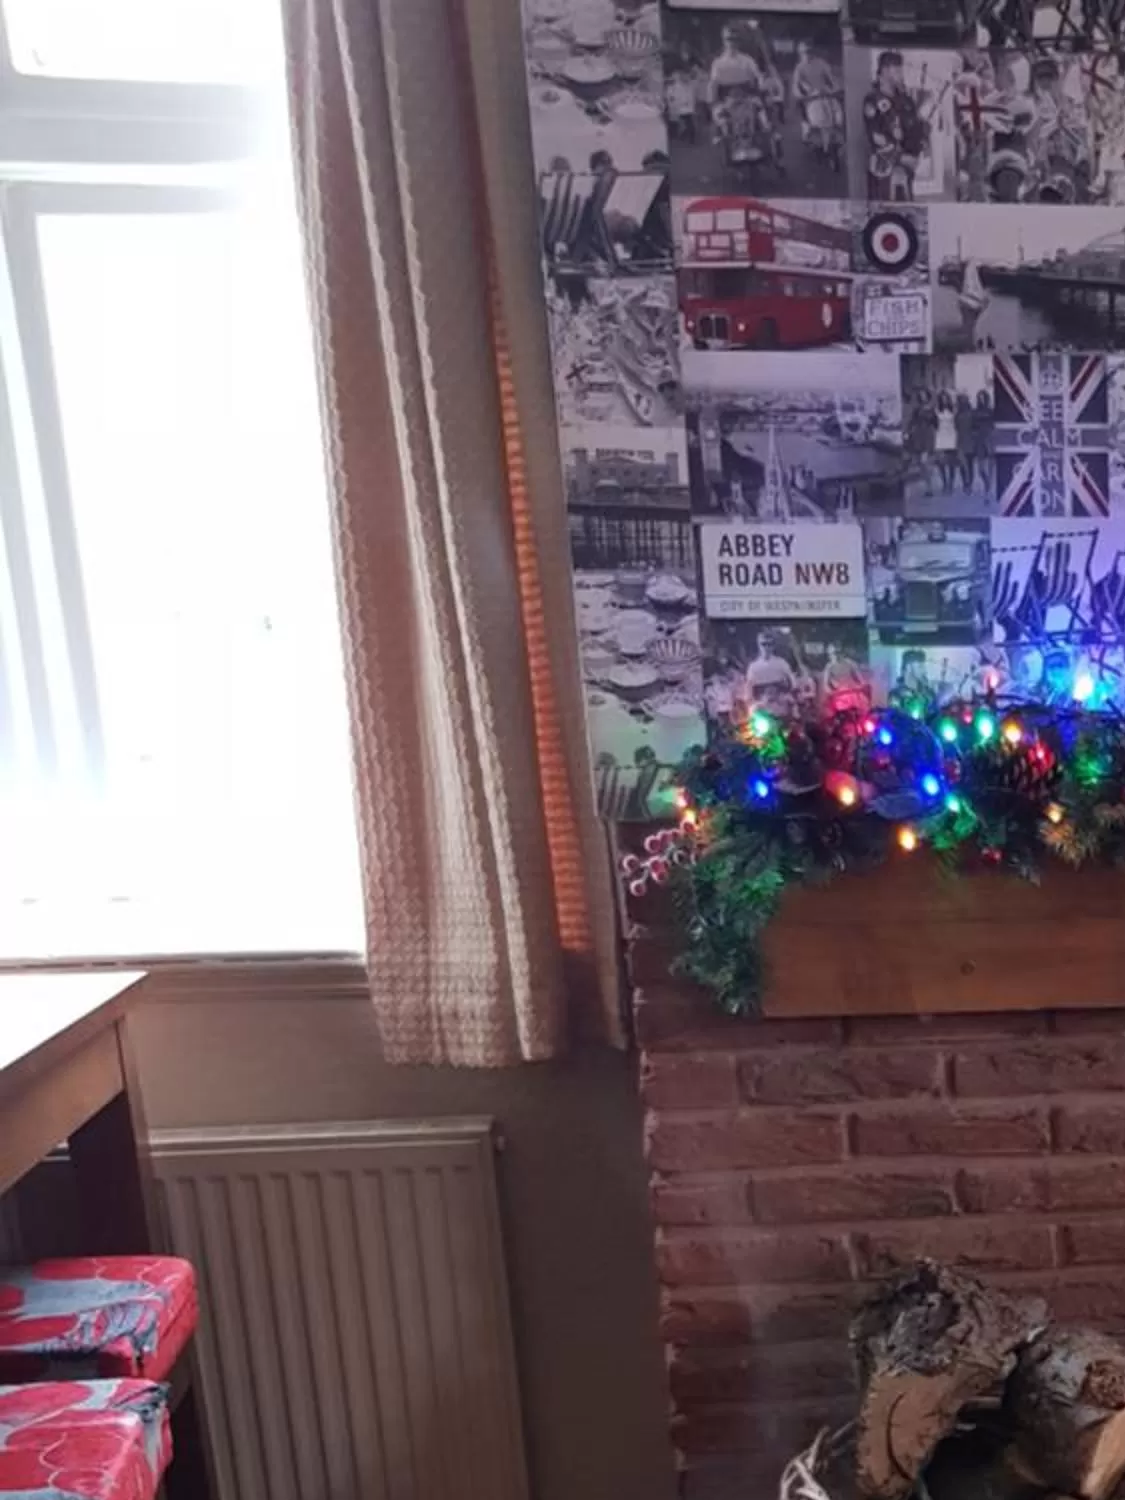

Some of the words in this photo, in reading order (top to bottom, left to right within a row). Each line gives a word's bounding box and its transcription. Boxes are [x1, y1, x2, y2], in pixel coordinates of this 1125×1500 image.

[718, 533, 794, 557] ABBEY
[719, 563, 783, 586] ROAD
[795, 562, 850, 585] NW8
